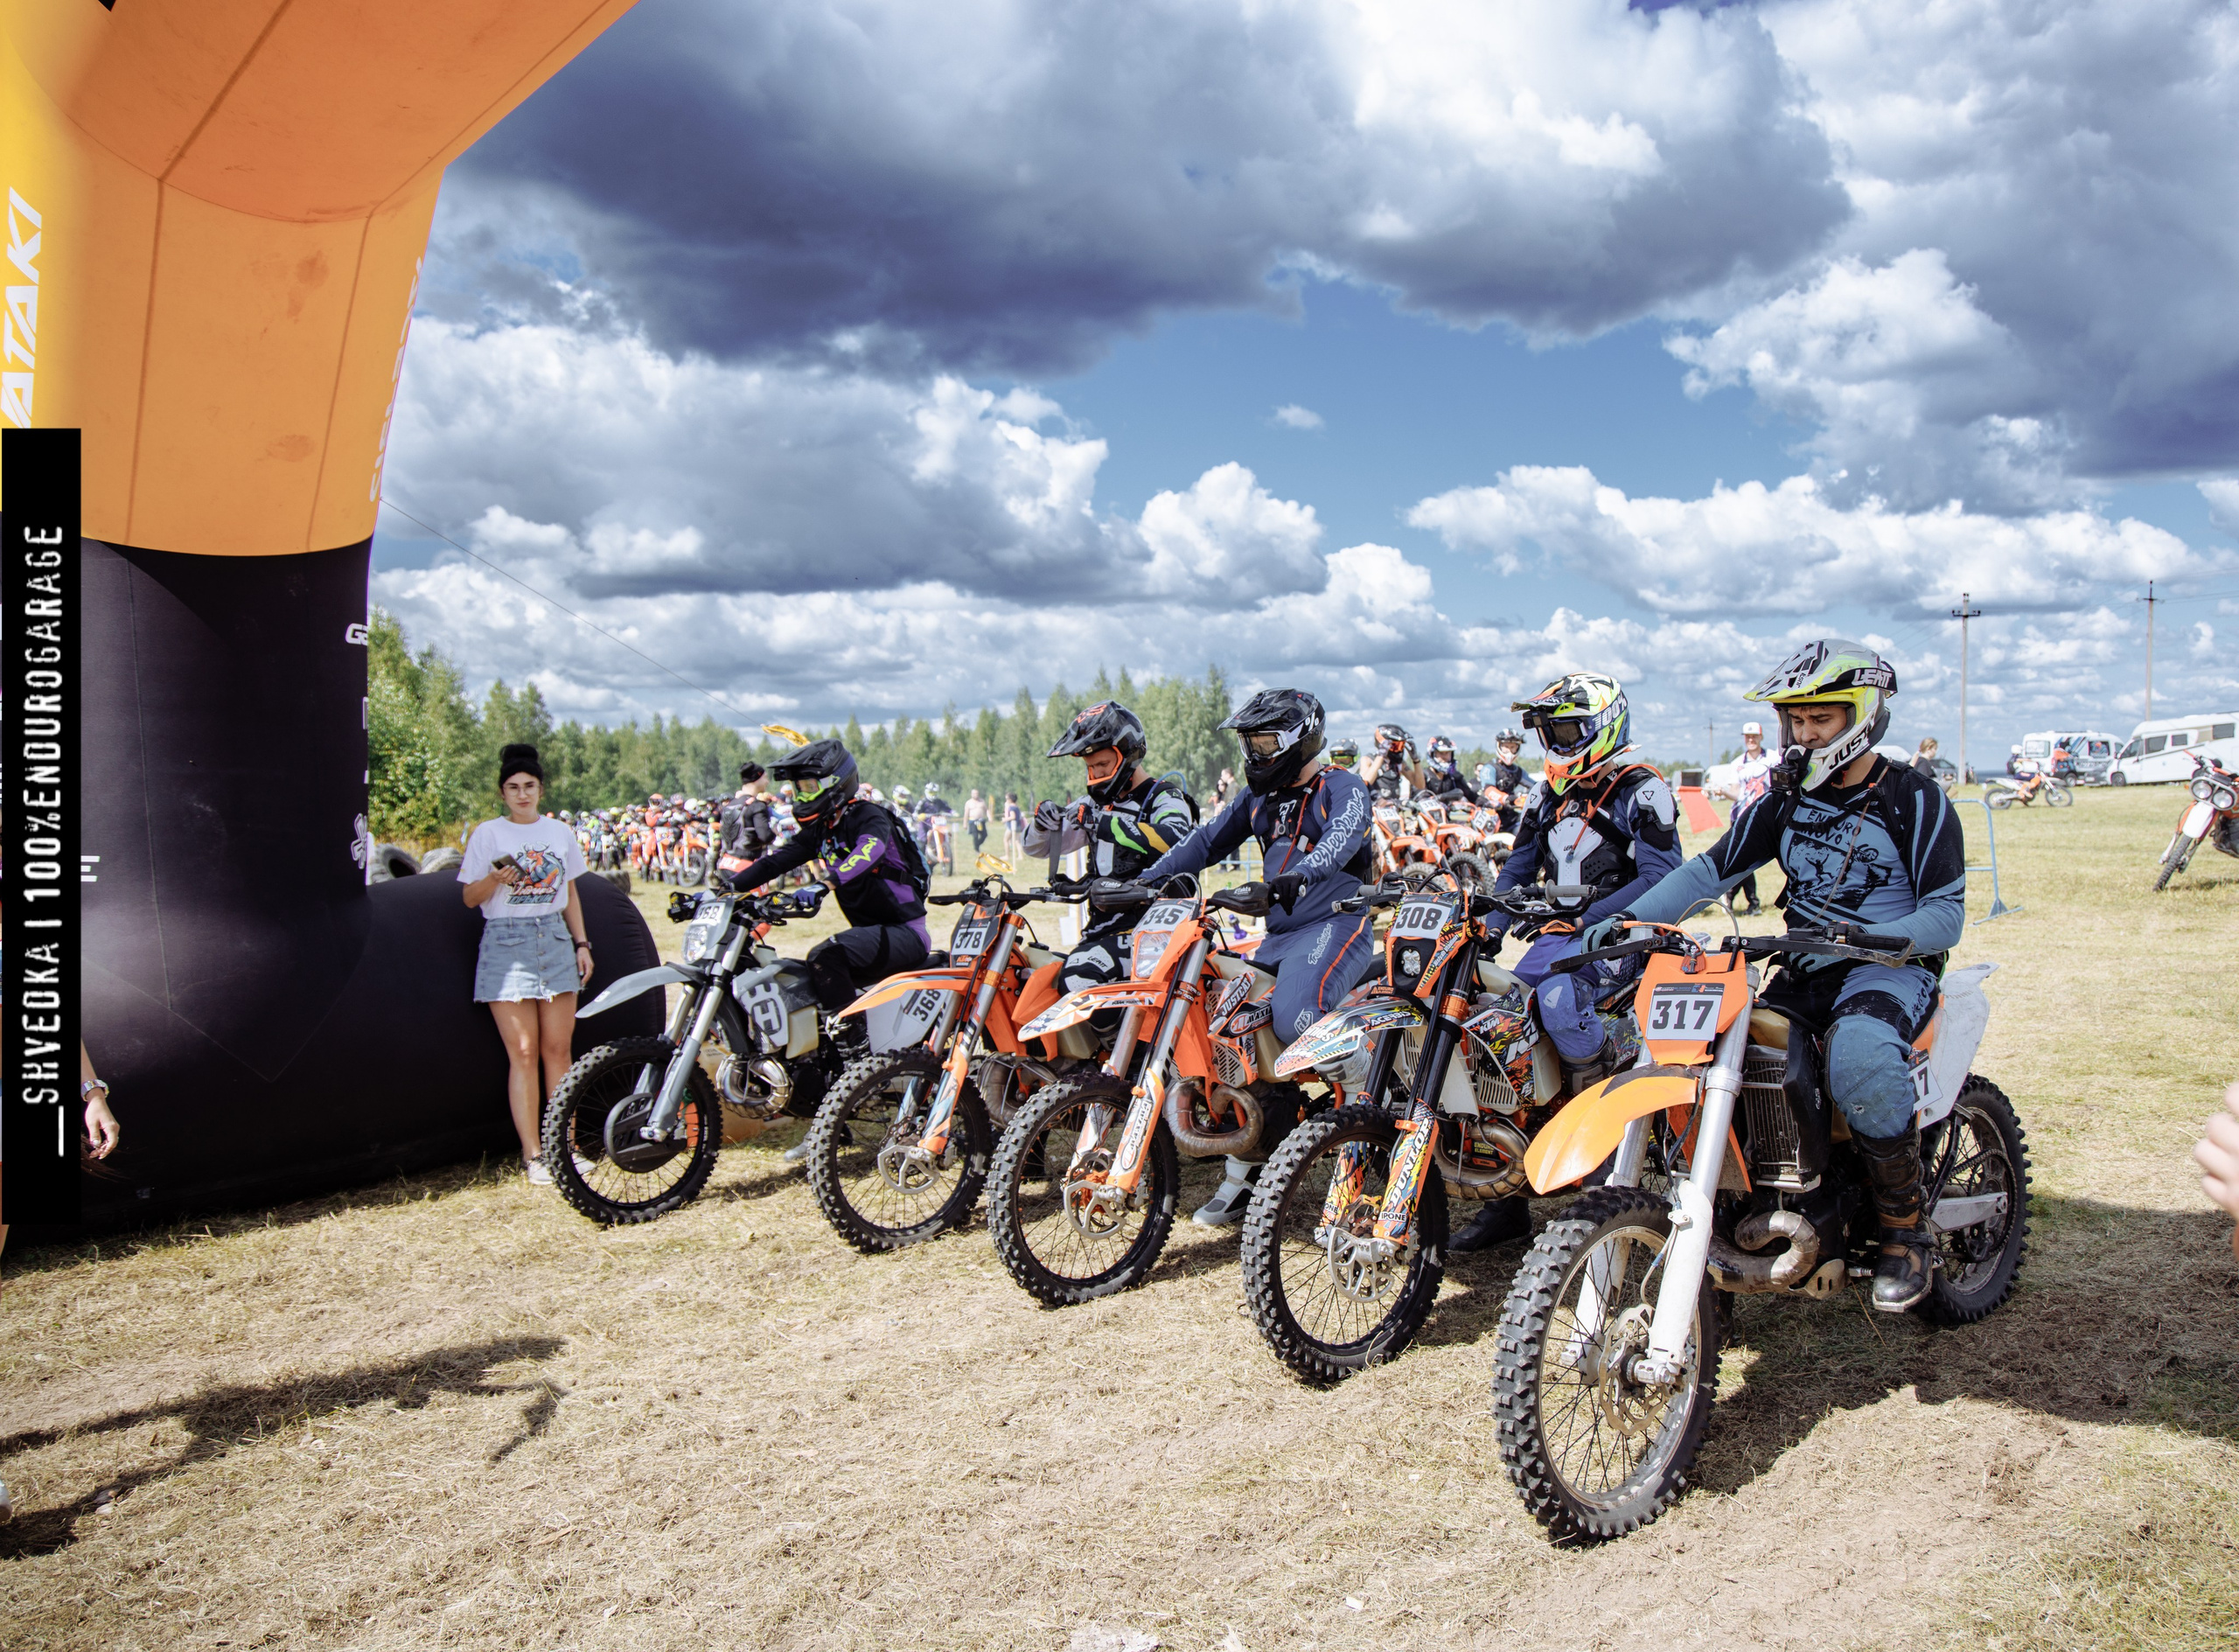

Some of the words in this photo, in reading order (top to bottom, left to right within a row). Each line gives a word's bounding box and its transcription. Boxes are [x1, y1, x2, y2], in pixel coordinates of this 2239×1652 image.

[1851, 667, 1893, 689] LEATT
[1807, 809, 1861, 838] ENURO
[1143, 906, 1184, 925] 345
[1395, 906, 1442, 931] 308
[955, 931, 982, 949] 378
[1087, 956, 1108, 968] LEATT
[912, 988, 941, 1022] 368
[1652, 1000, 1714, 1030] 317
[1479, 1016, 1501, 1035] KTM
[1389, 1117, 1430, 1206] DUNLOP
[1381, 1212, 1406, 1222] IPONE
